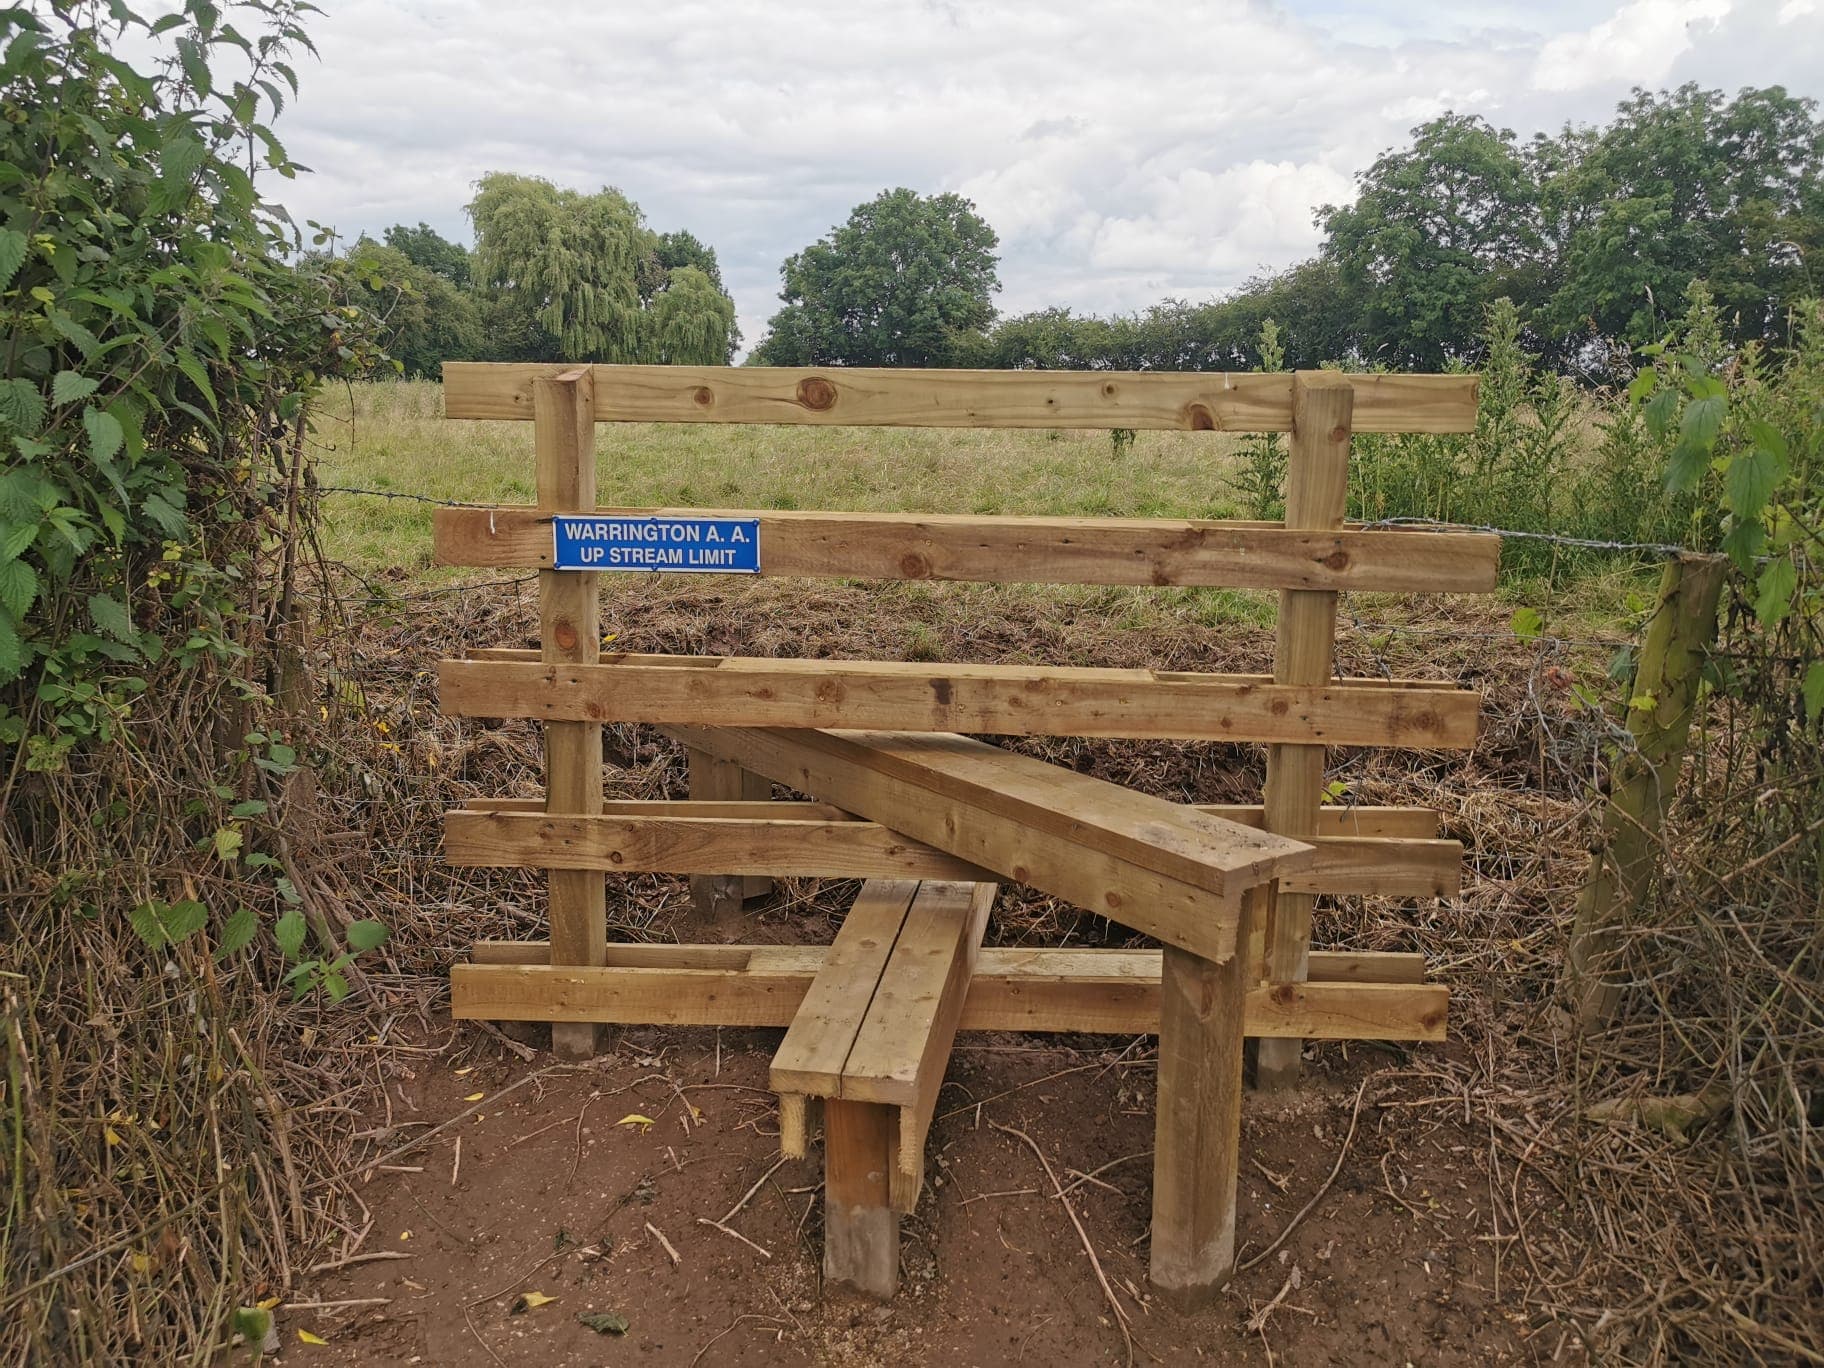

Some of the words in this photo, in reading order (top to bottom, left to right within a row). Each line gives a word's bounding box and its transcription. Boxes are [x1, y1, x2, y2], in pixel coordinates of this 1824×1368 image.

[565, 523, 699, 542] WARRINGTON
[706, 525, 725, 542] A.
[731, 526, 750, 543] A.
[580, 547, 604, 563] UP
[610, 547, 683, 564] STREAM
[689, 549, 736, 565] LIMIT
